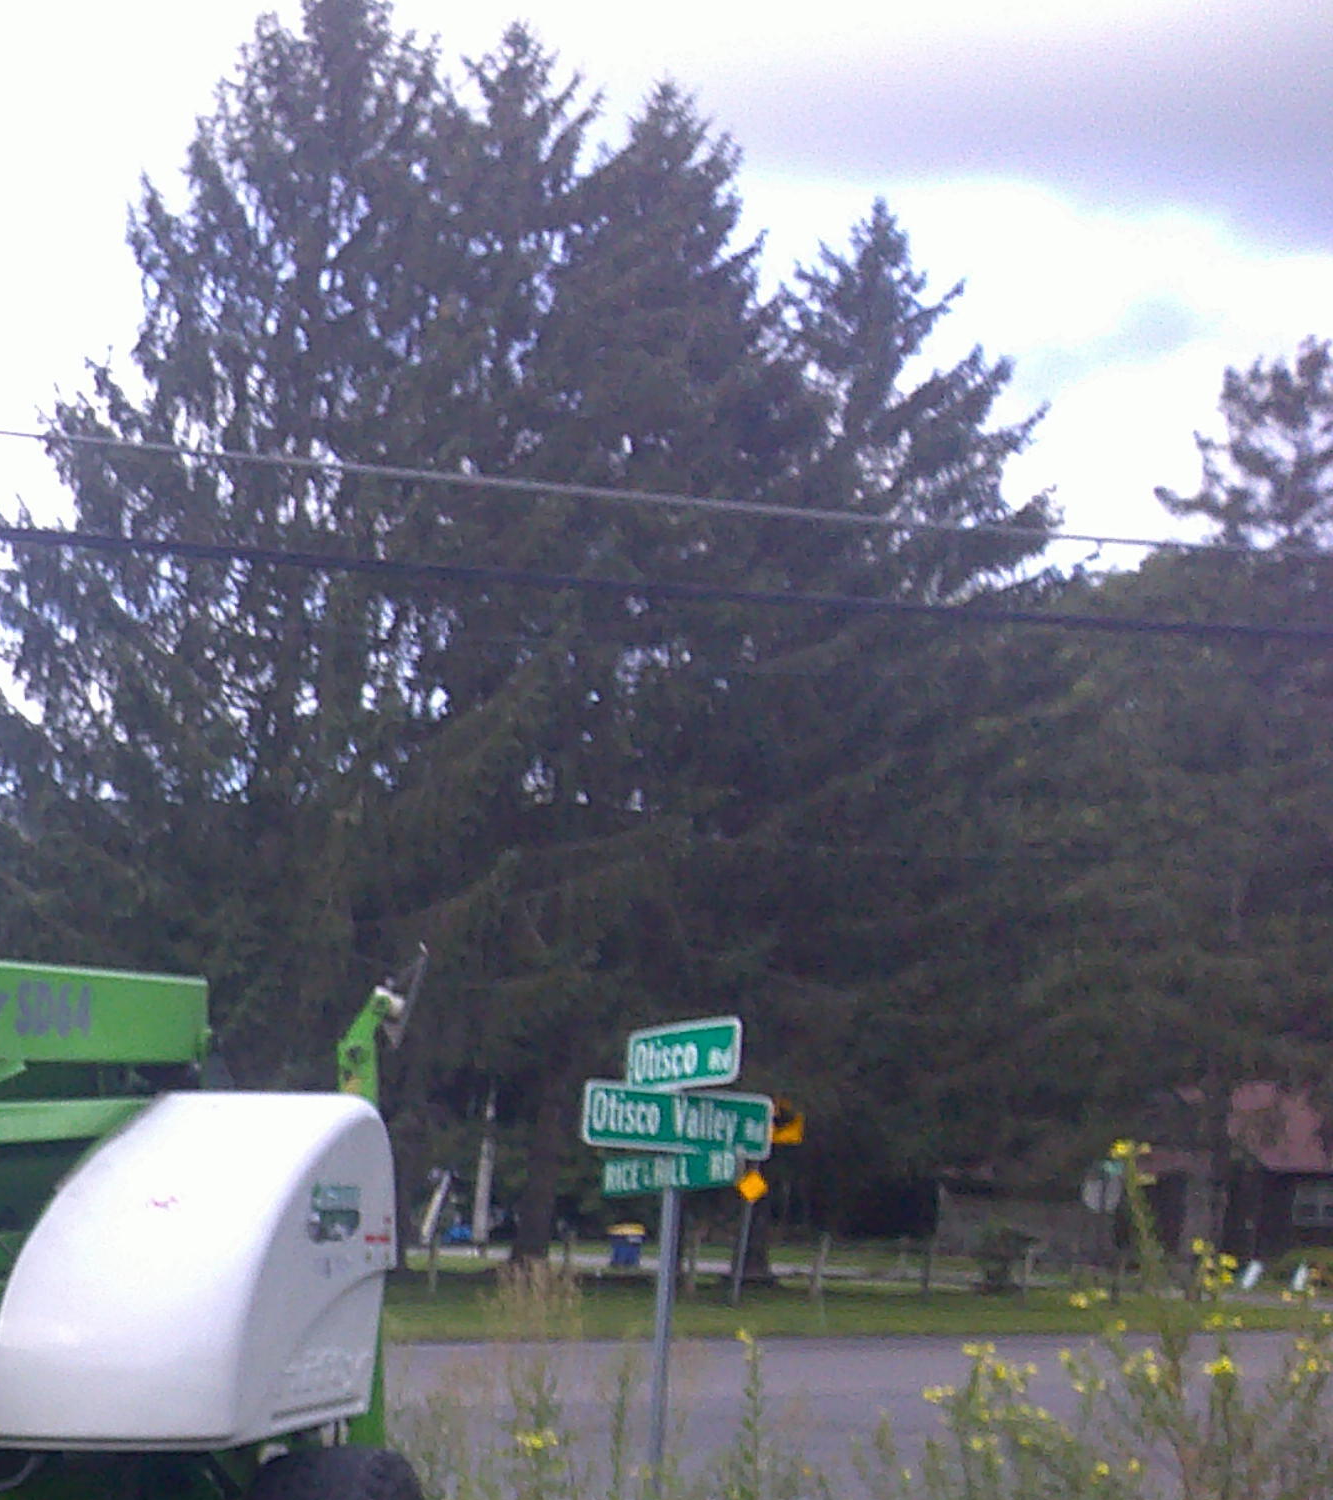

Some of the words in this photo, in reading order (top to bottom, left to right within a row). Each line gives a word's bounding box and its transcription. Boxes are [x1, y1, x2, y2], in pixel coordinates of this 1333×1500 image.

[14, 979, 91, 1039] SD64
[634, 1038, 699, 1083] Otisco
[592, 1091, 662, 1137] Otisco
[672, 1095, 739, 1149] Valley
[709, 1150, 736, 1182] RD
